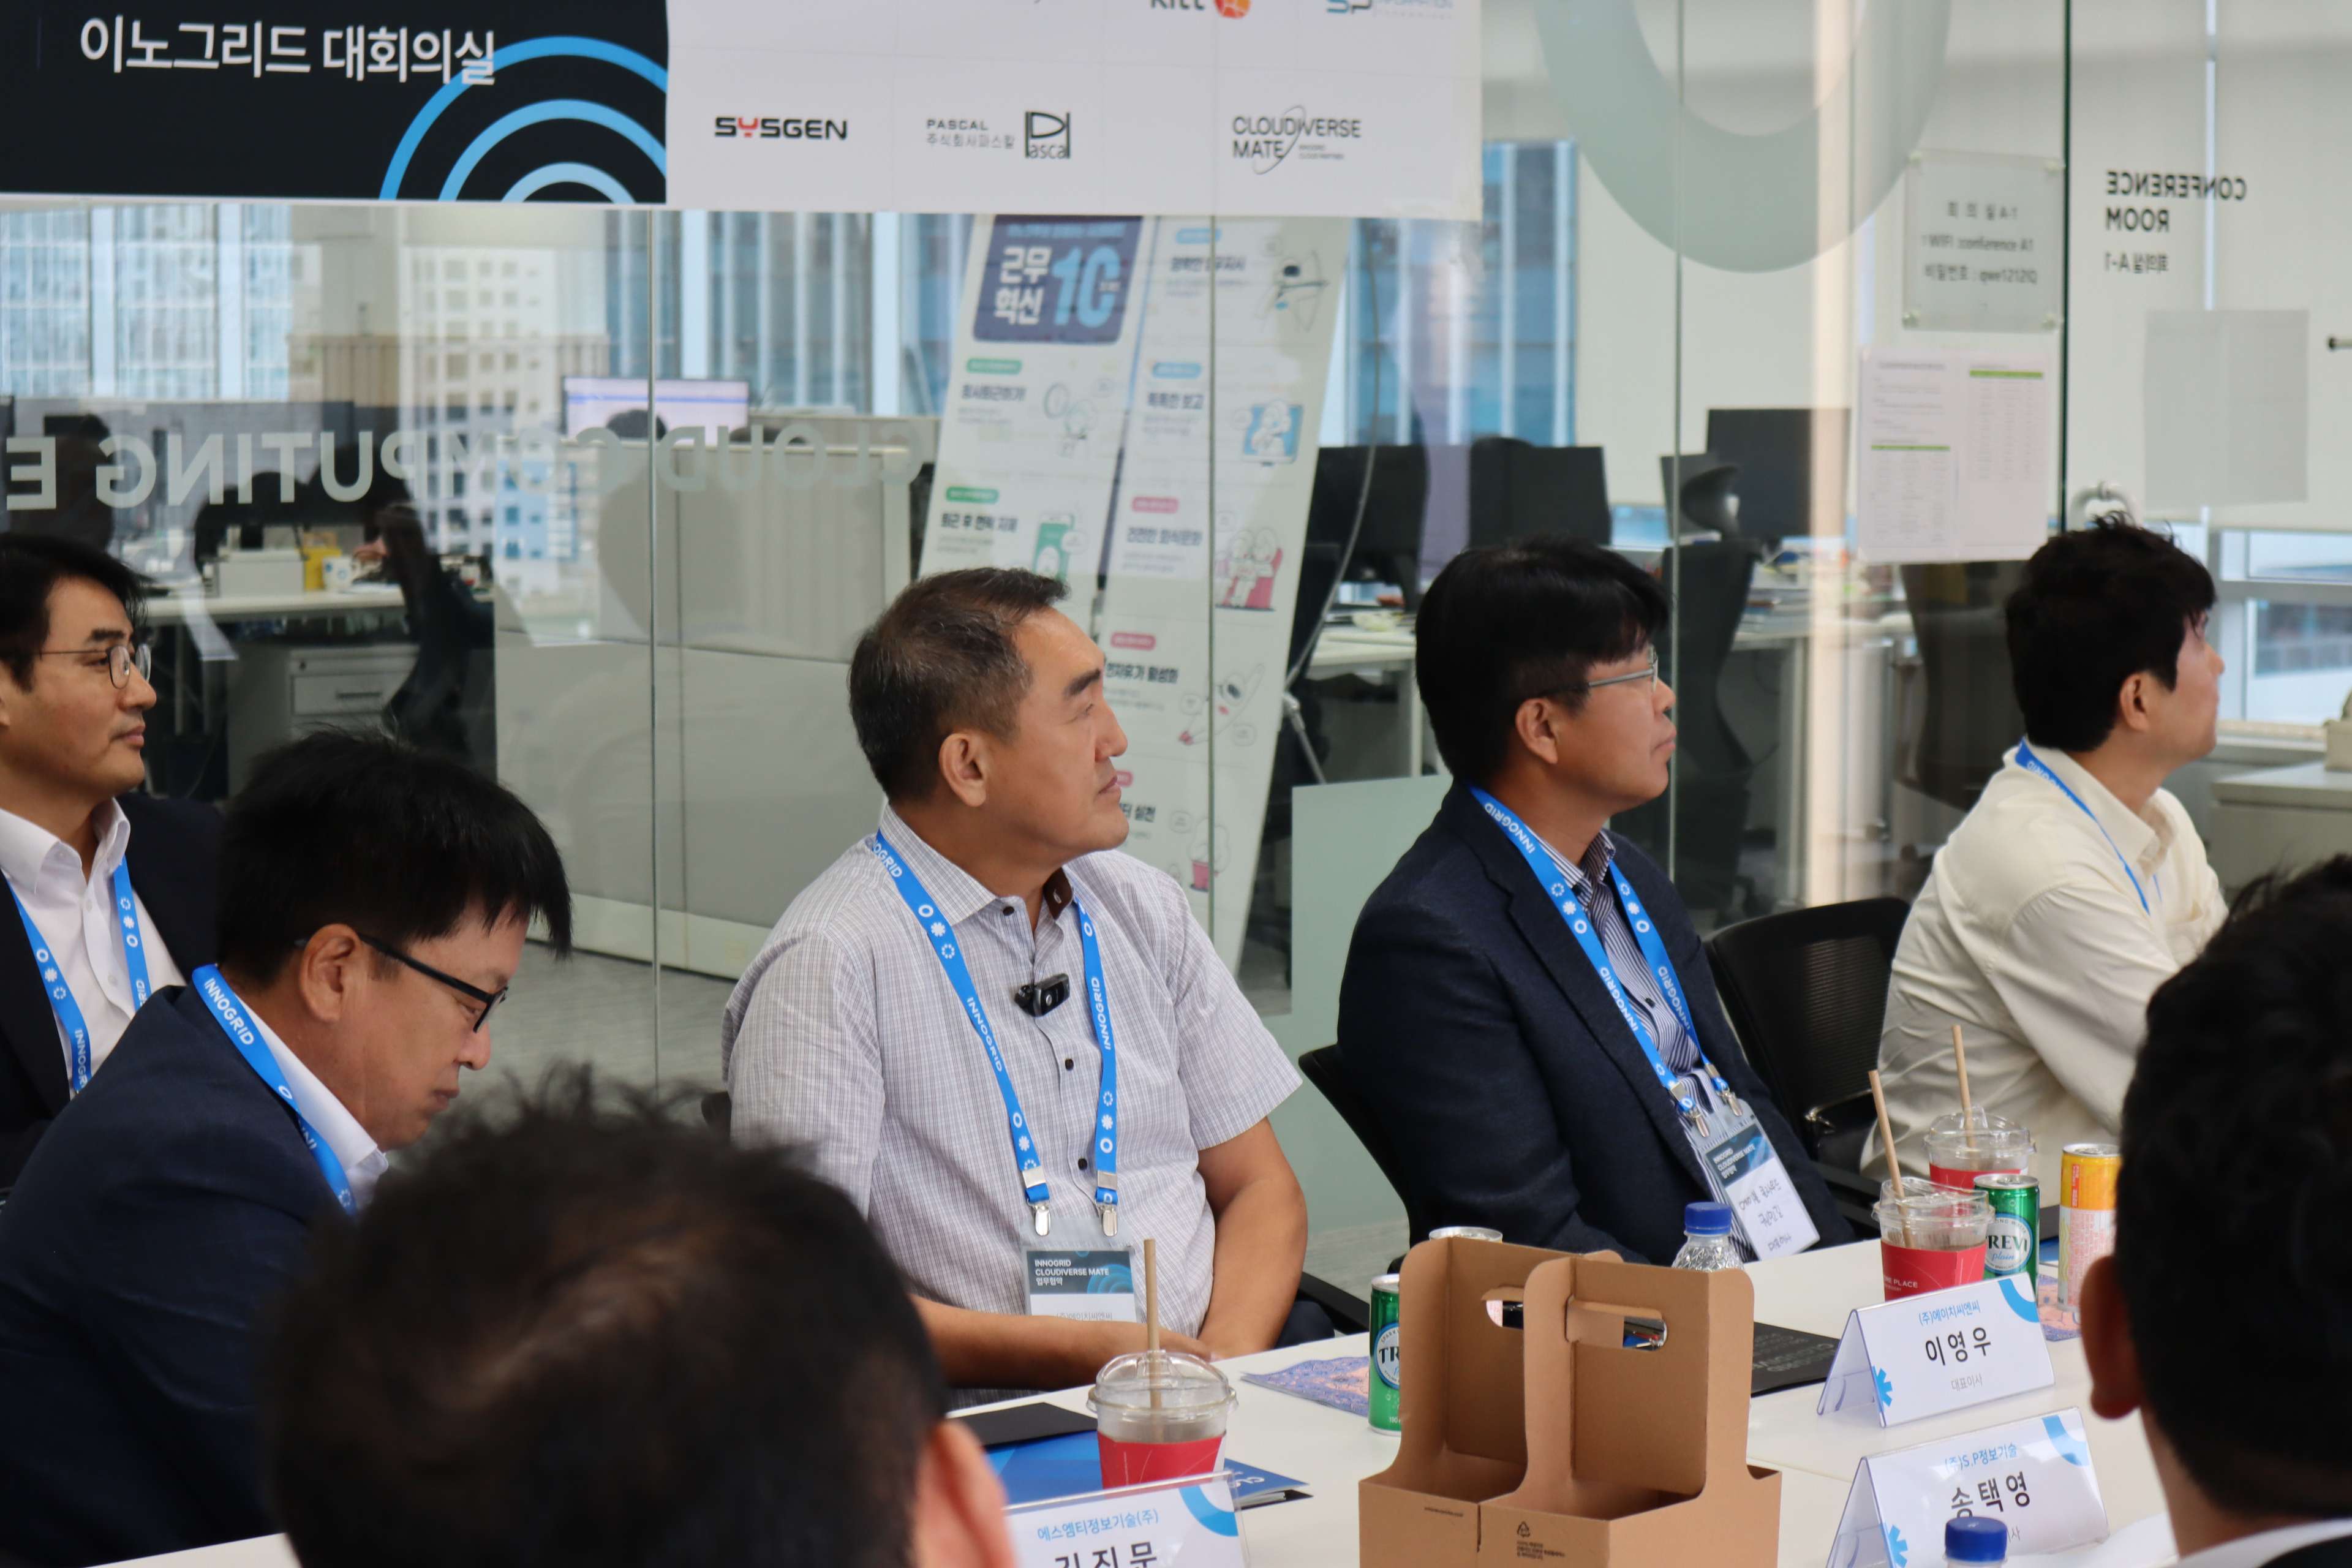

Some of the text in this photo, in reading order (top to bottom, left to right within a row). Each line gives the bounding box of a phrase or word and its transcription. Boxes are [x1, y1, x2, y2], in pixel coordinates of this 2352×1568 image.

[80, 15, 496, 85] 이노그리드 대회의실
[714, 117, 848, 141] SYSGEN
[927, 119, 989, 131] PASCAL
[1233, 116, 1362, 138] CLOUDIVERSE
[1233, 140, 1284, 159] MATE
[999, 246, 1052, 284] 근무
[993, 286, 1044, 325] 혁신
[1484, 802, 1536, 854] INNOGRID
[204, 978, 255, 1046] INNOGRID
[1091, 977, 1112, 1051] INNOGRID
[1599, 966, 1639, 1032] INNOGRID
[1657, 965, 1691, 1030] INNOGRID
[967, 997, 1003, 1072] INNOGRID
[1986, 1235, 2027, 1253] REVI
[1035, 1259, 1071, 1267] INNOGRID
[1035, 1267, 1110, 1276] CLOUDIVERSE MATE
[1036, 1276, 1063, 1286] 업무협약
[1893, 1279, 1918, 1289] PLACE
[1918, 1299, 1981, 1326] (주)에이치씨엔씨
[1925, 1327, 1991, 1366] 이영우
[1951, 1373, 1983, 1392] 대표이사
[1951, 1471, 2030, 1518] 송택영
[1037, 1509, 1159, 1542] 에스엠티정보기술(주)
